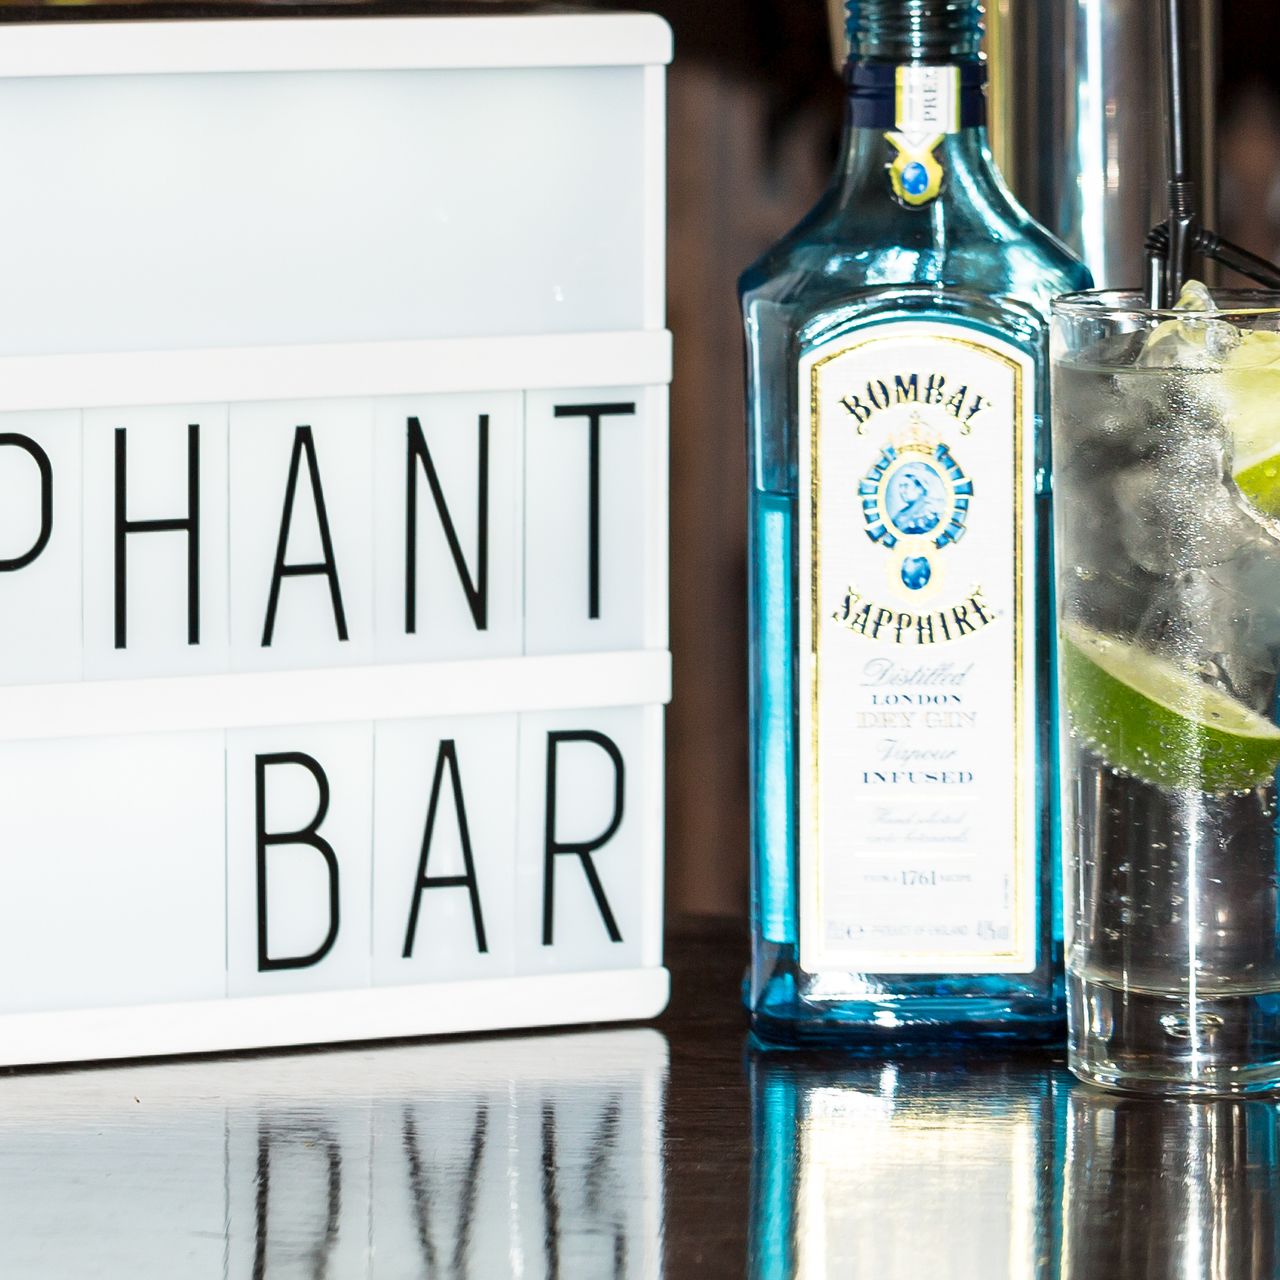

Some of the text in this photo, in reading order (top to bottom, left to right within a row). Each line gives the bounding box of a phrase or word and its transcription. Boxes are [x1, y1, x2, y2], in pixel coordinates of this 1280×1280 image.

[837, 372, 993, 436] BOMBAY
[832, 583, 999, 645] SAPPHIRE
[871, 693, 963, 706] LONDON
[861, 770, 976, 785] INFUSED
[254, 729, 627, 974] BAR
